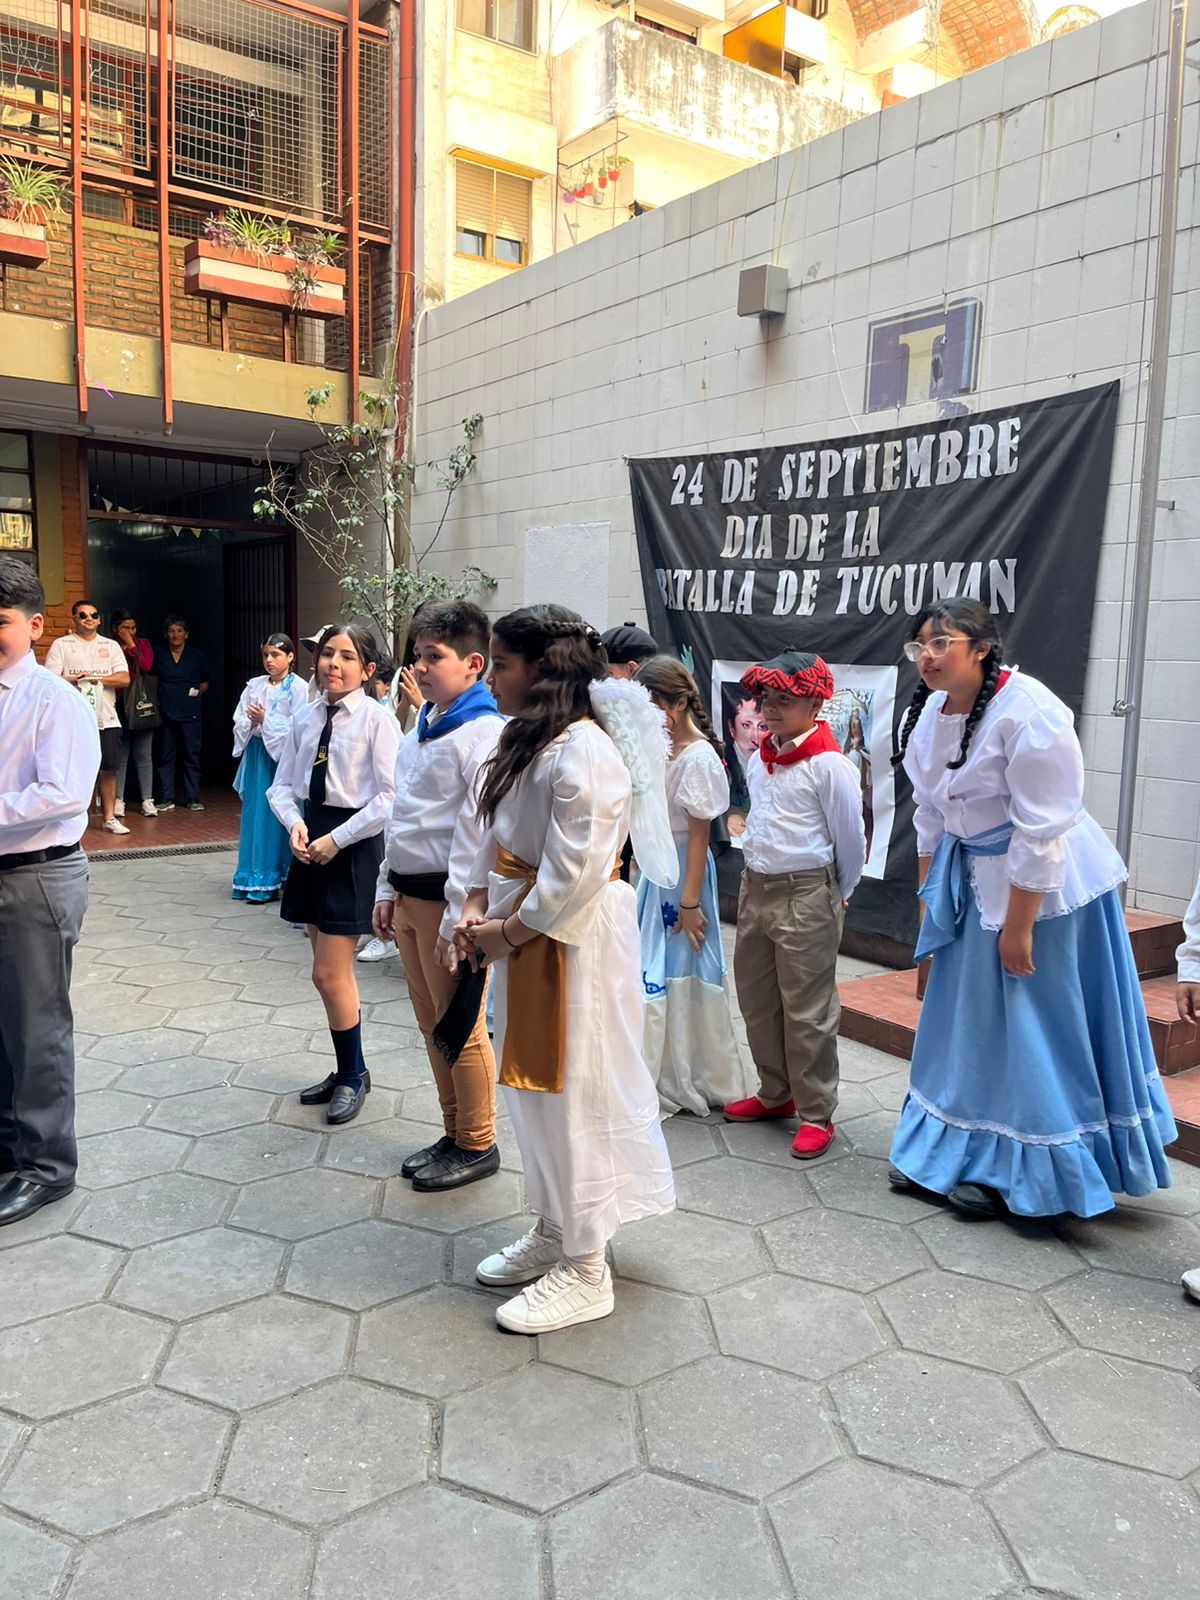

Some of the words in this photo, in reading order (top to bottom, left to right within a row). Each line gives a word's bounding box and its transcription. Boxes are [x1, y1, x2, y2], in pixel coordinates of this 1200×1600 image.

[670, 462, 705, 506] 24
[720, 457, 760, 504] DE
[777, 416, 1022, 501] SEPTIEMBRE
[719, 513, 773, 560] DIA
[784, 513, 830, 562] DE
[841, 506, 880, 559] LA
[772, 569, 821, 617] DE
[834, 558, 1018, 617] TUCUMAN
